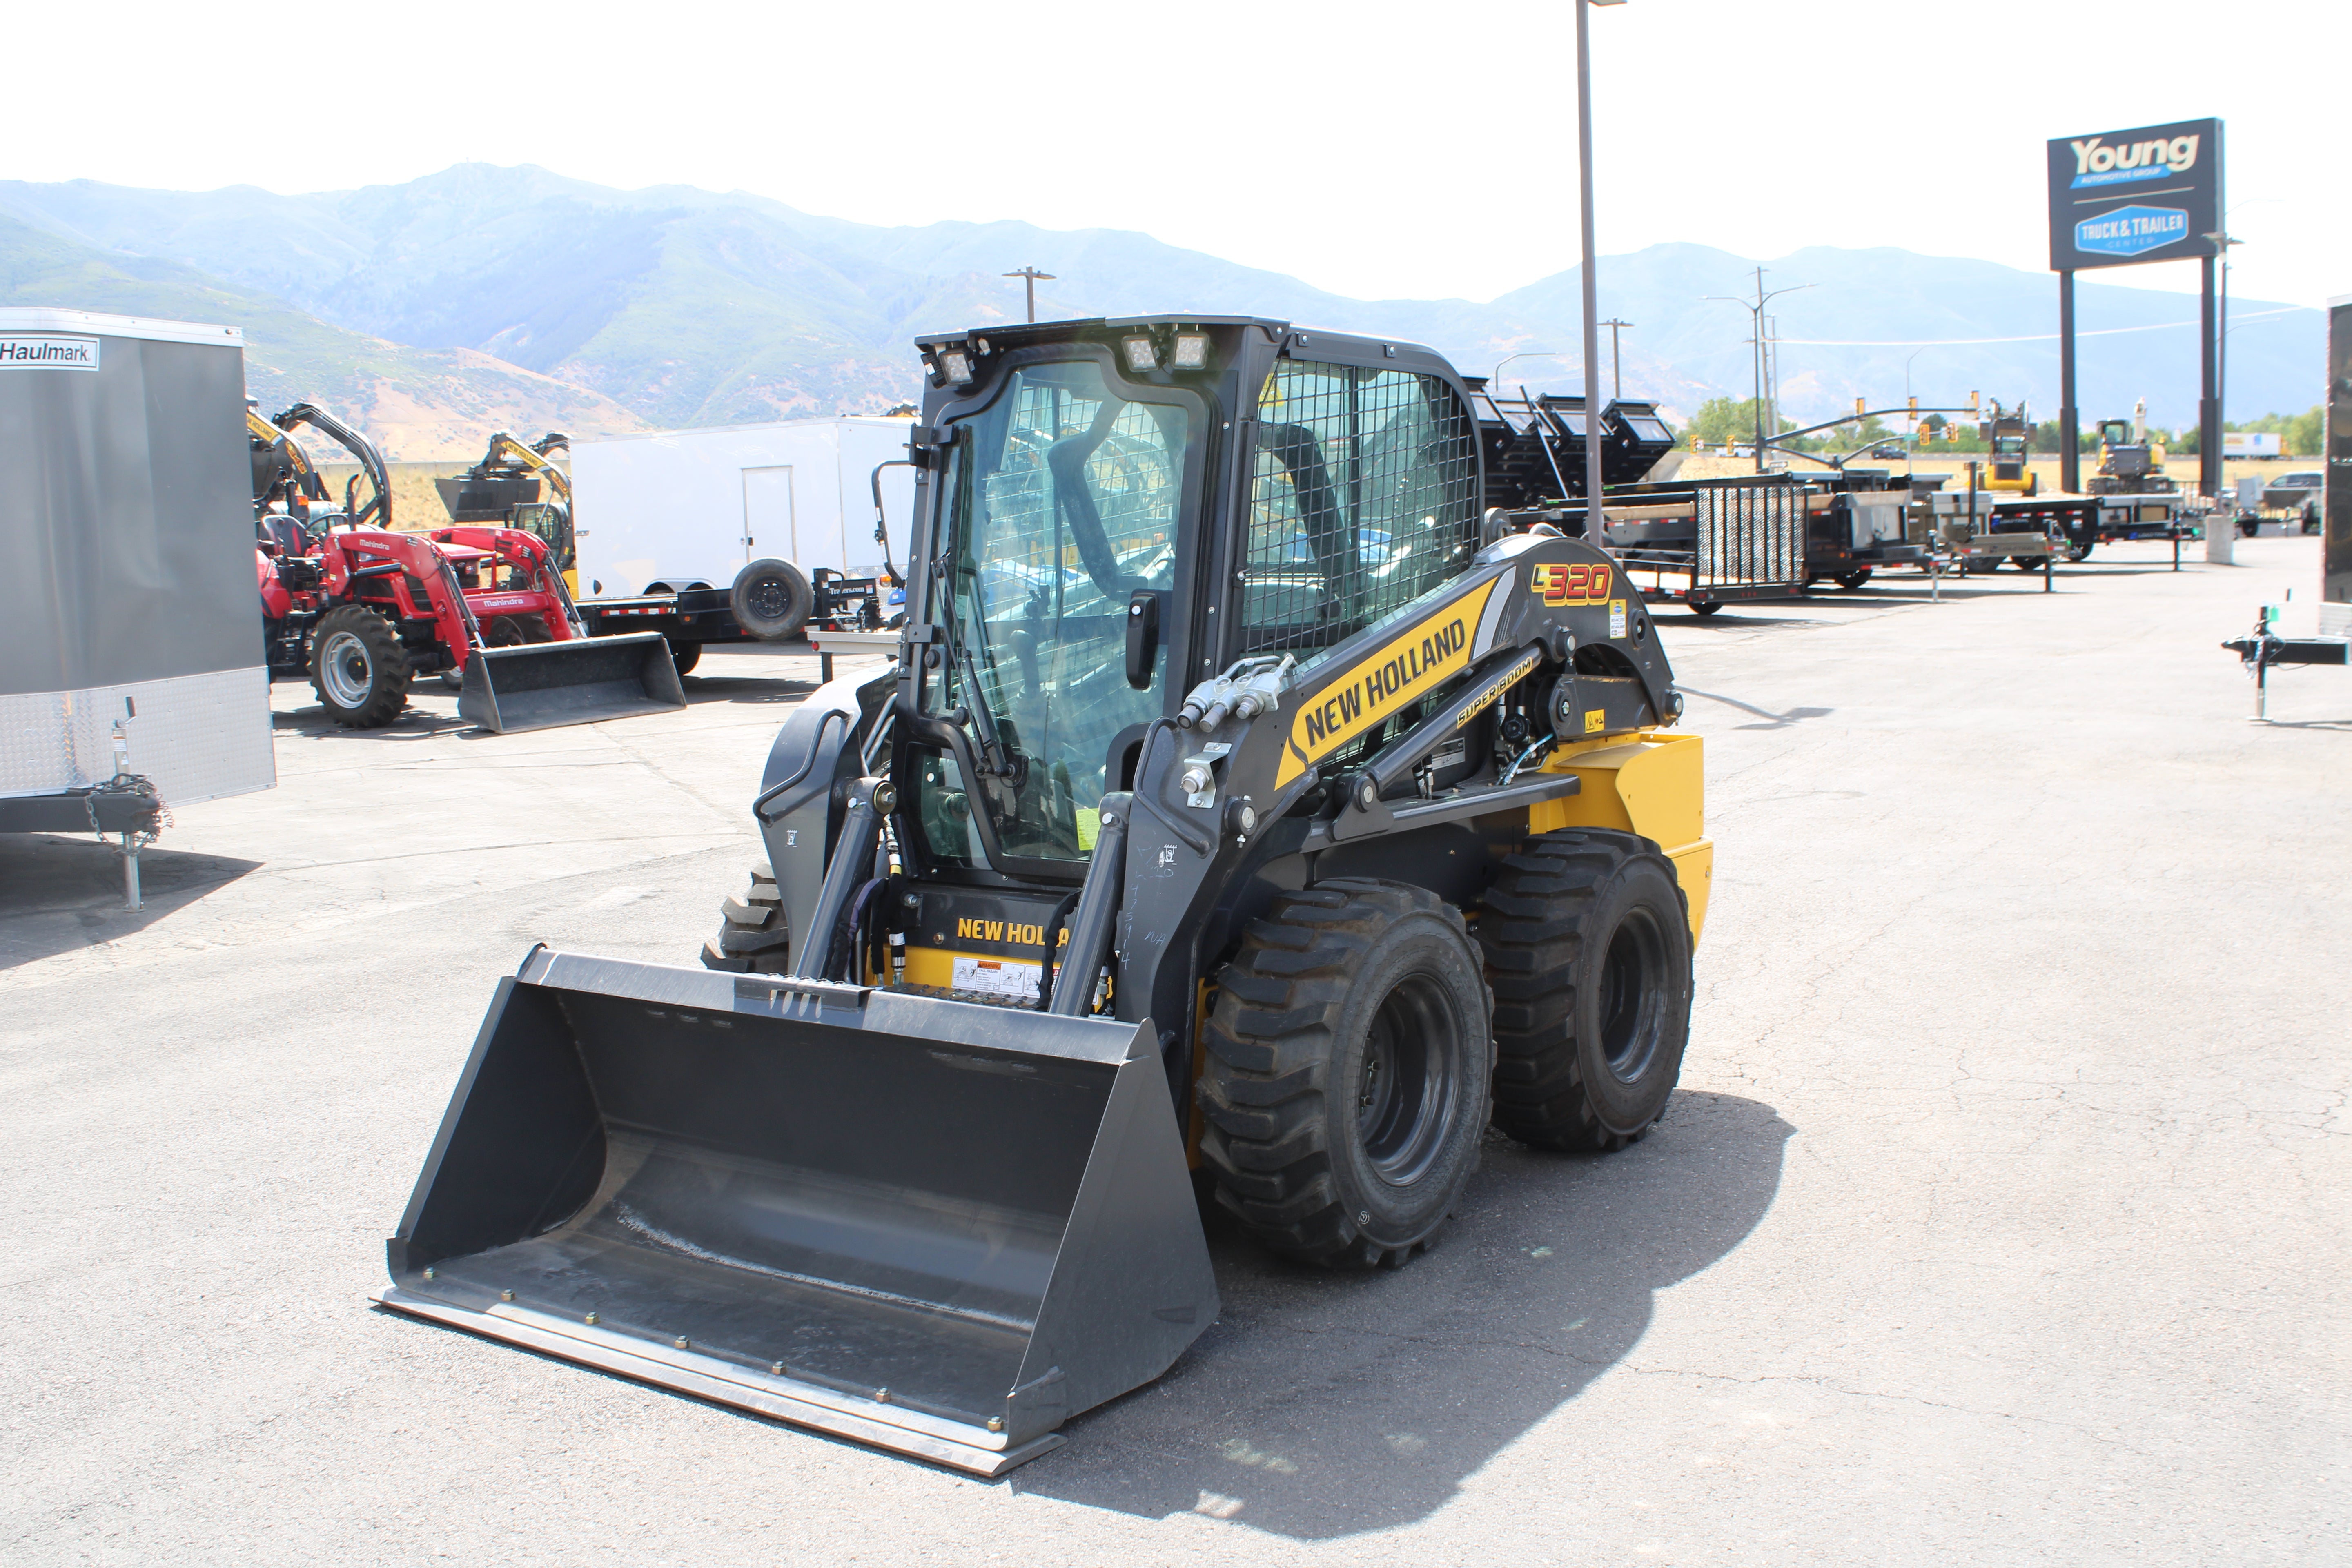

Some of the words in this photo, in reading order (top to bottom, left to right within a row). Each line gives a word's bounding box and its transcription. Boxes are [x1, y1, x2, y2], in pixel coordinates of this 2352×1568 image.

[2070, 134, 2200, 174] Young
[2081, 171, 2131, 183] AUTOMOTIVE
[2132, 167, 2161, 177] GROUP
[2082, 220, 2119, 240] TRUCK
[2120, 219, 2131, 237] &
[2131, 214, 2184, 236] TRAILER
[0, 343, 88, 361] Haulmark
[360, 539, 390, 550] Mahindra
[1532, 565, 1611, 602] L320
[483, 599, 524, 607] Mahindra
[1305, 682, 1361, 744] NEW
[1365, 618, 1465, 709] HOLLAND
[1457, 684, 1498, 726] SUPER
[1498, 656, 1533, 693] BOOM
[958, 918, 1004, 941] NEW
[1007, 922, 1069, 948] HOLA
